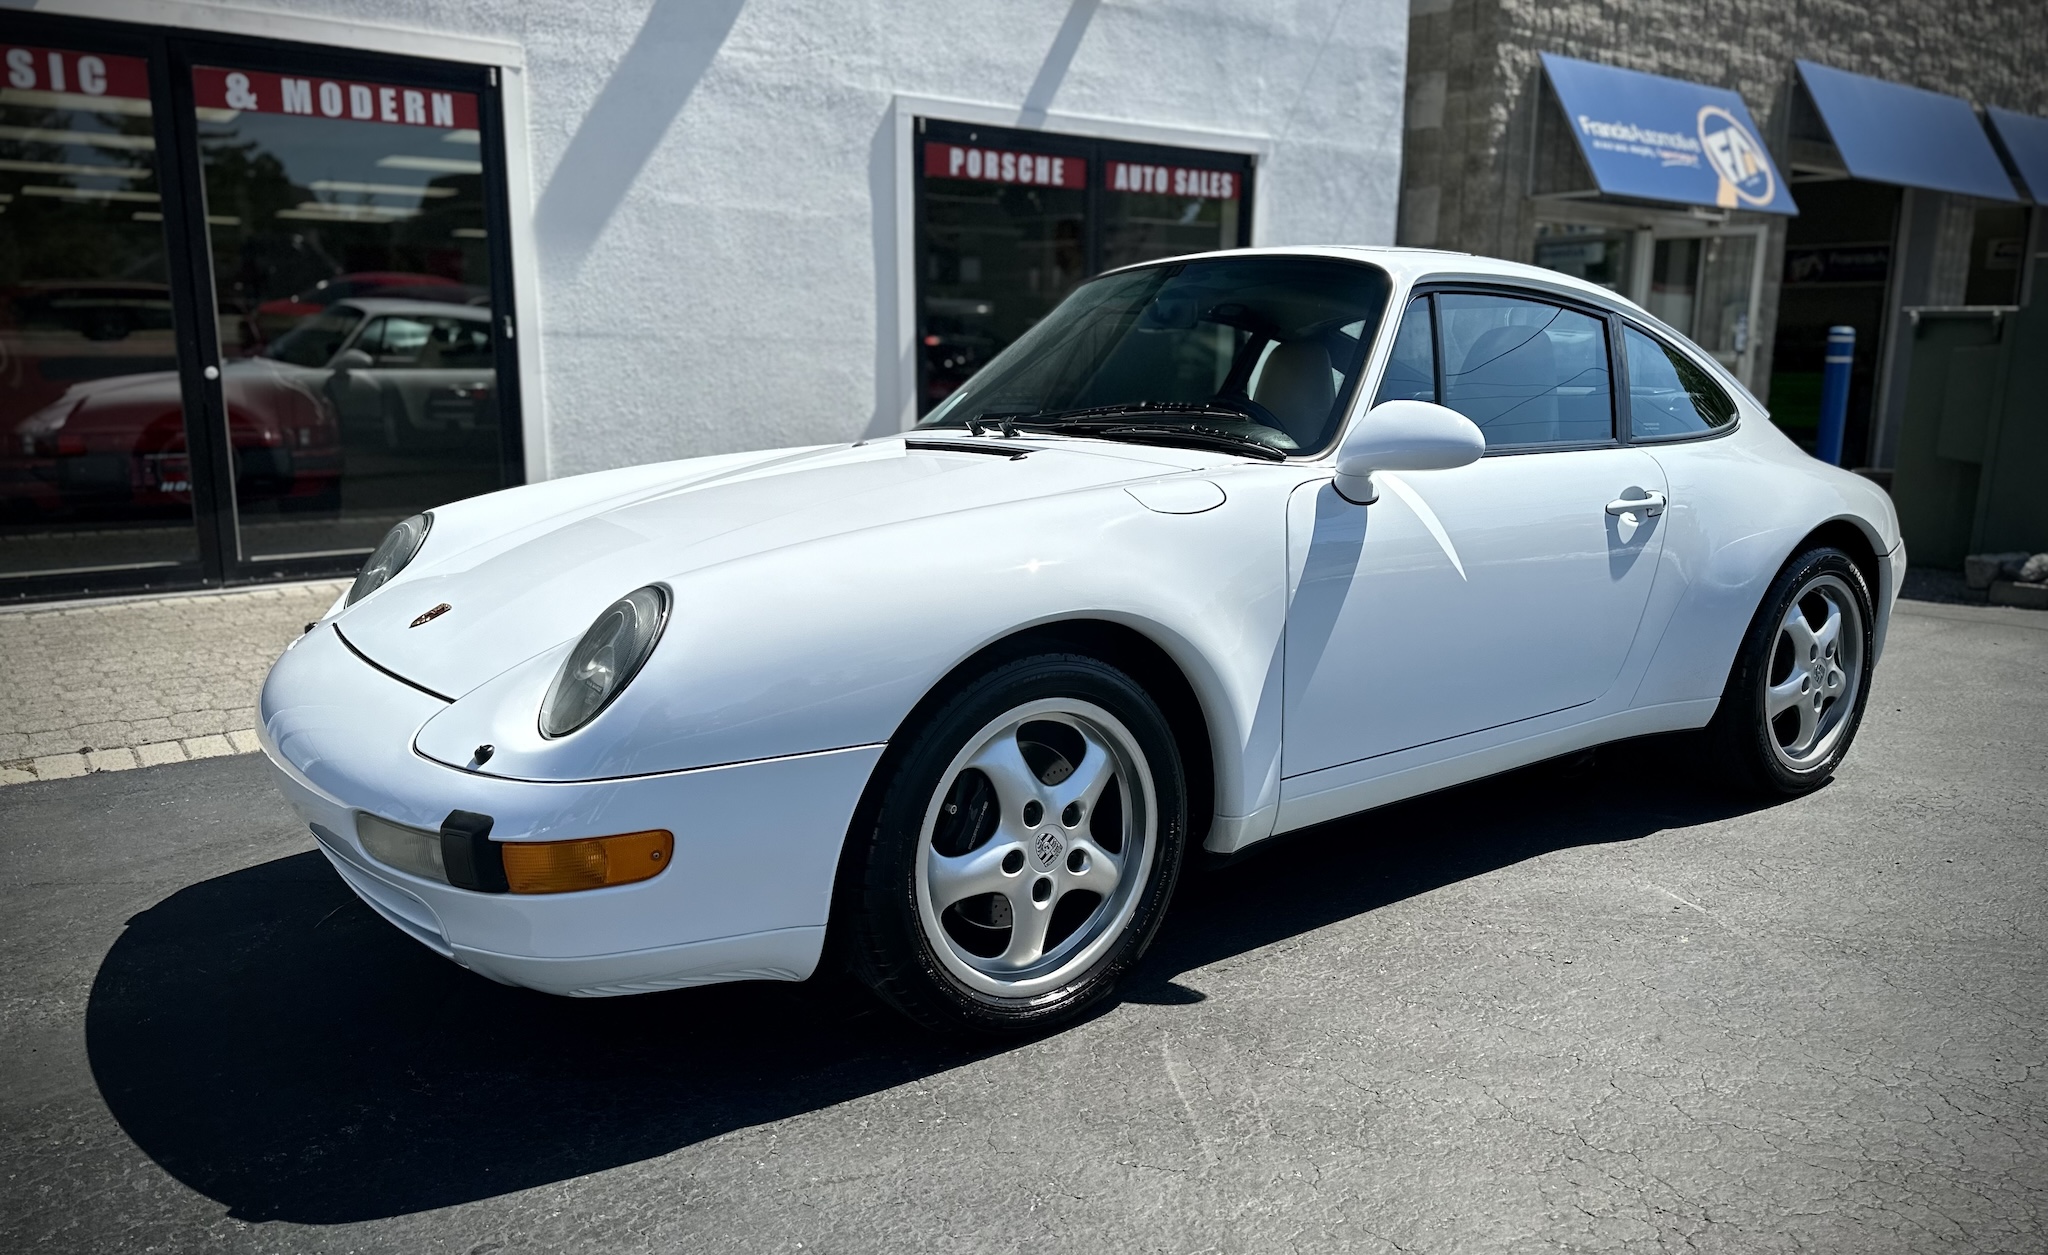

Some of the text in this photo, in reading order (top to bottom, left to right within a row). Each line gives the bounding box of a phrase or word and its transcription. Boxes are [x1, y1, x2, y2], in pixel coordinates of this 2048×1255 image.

[225, 72, 454, 127] & MODERN
[949, 147, 1064, 185] PORSCHE
[1114, 163, 1234, 199] AUTO SALES
